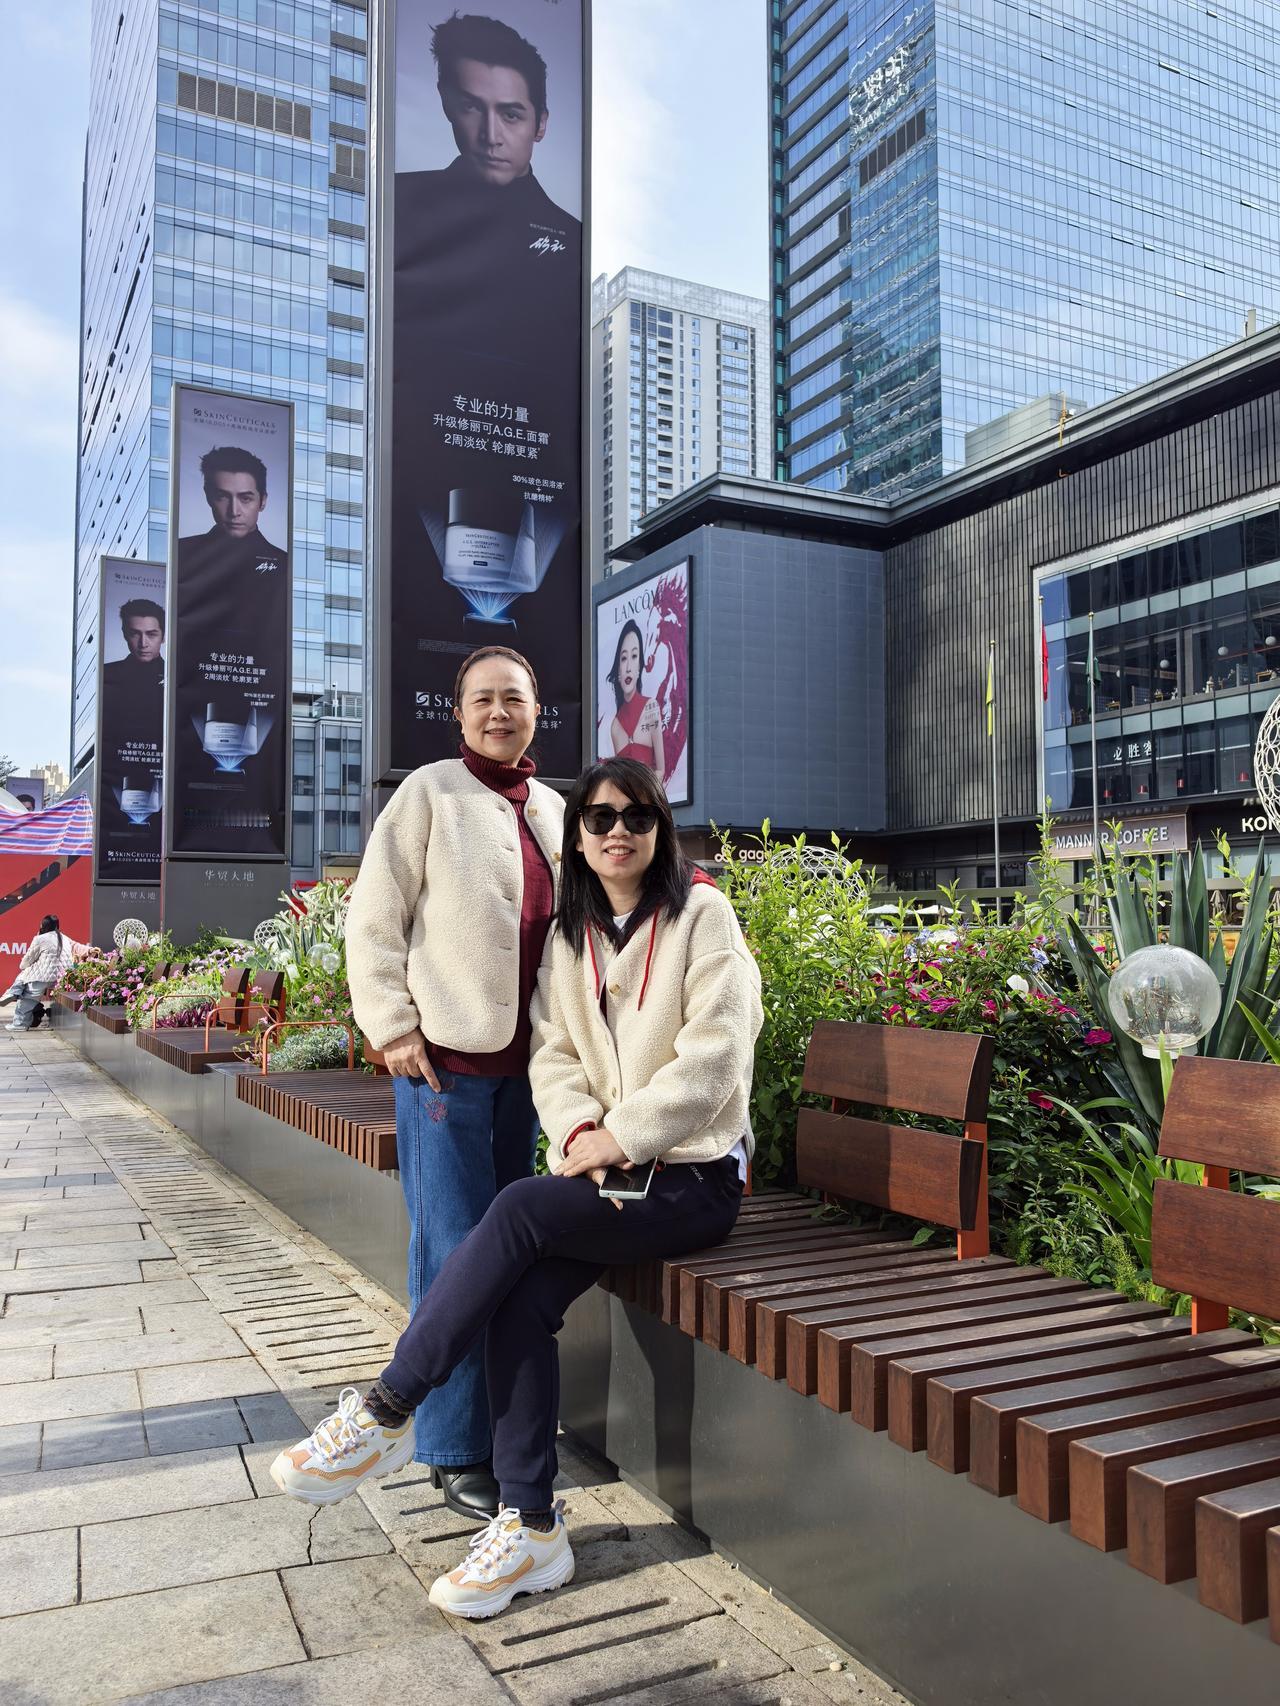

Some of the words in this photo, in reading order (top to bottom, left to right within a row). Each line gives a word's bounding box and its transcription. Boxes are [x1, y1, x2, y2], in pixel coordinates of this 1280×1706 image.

[453, 395, 529, 423] 专业的力量
[434, 694, 453, 708] SK
[1113, 740, 1152, 761] 必胜客
[1056, 832, 1109, 849] MANNR
[0, 942, 27, 954] AM
